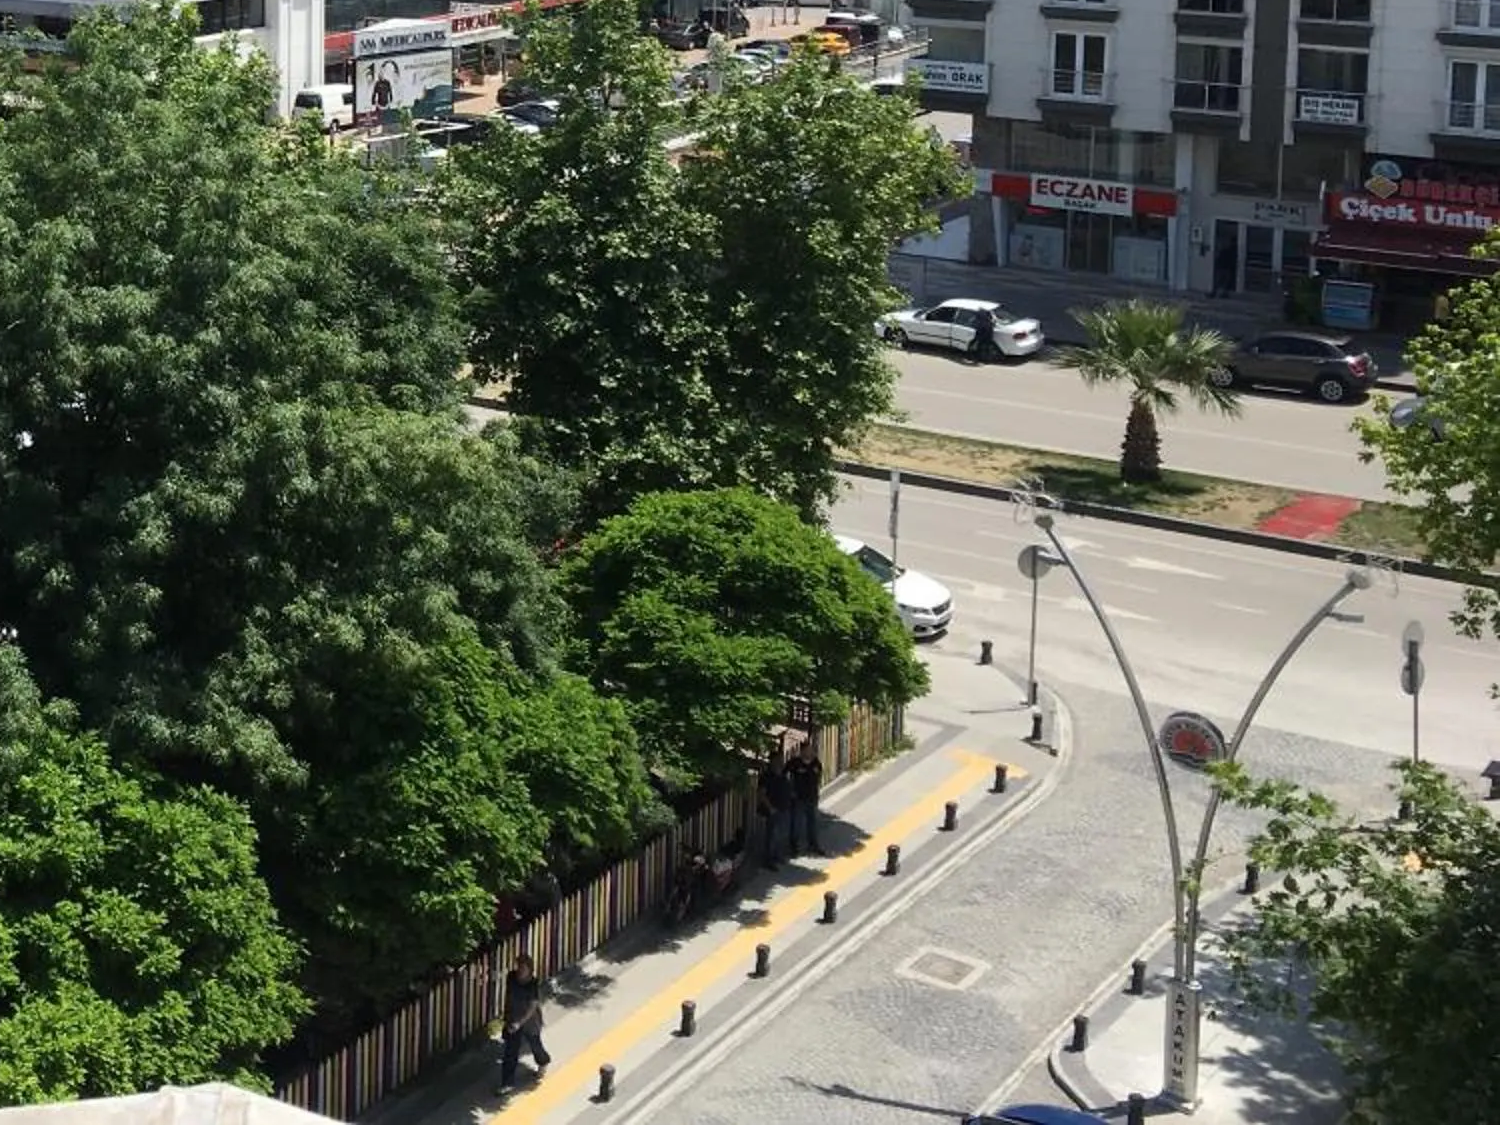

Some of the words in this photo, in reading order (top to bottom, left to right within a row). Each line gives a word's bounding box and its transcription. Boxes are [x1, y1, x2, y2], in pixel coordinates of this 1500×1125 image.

[380, 30, 446, 47] MEDICALPARK
[1037, 178, 1129, 204] ECZANE
[1340, 197, 1417, 223] Çiçek
[1173, 994, 1185, 1079] ATAKUM
